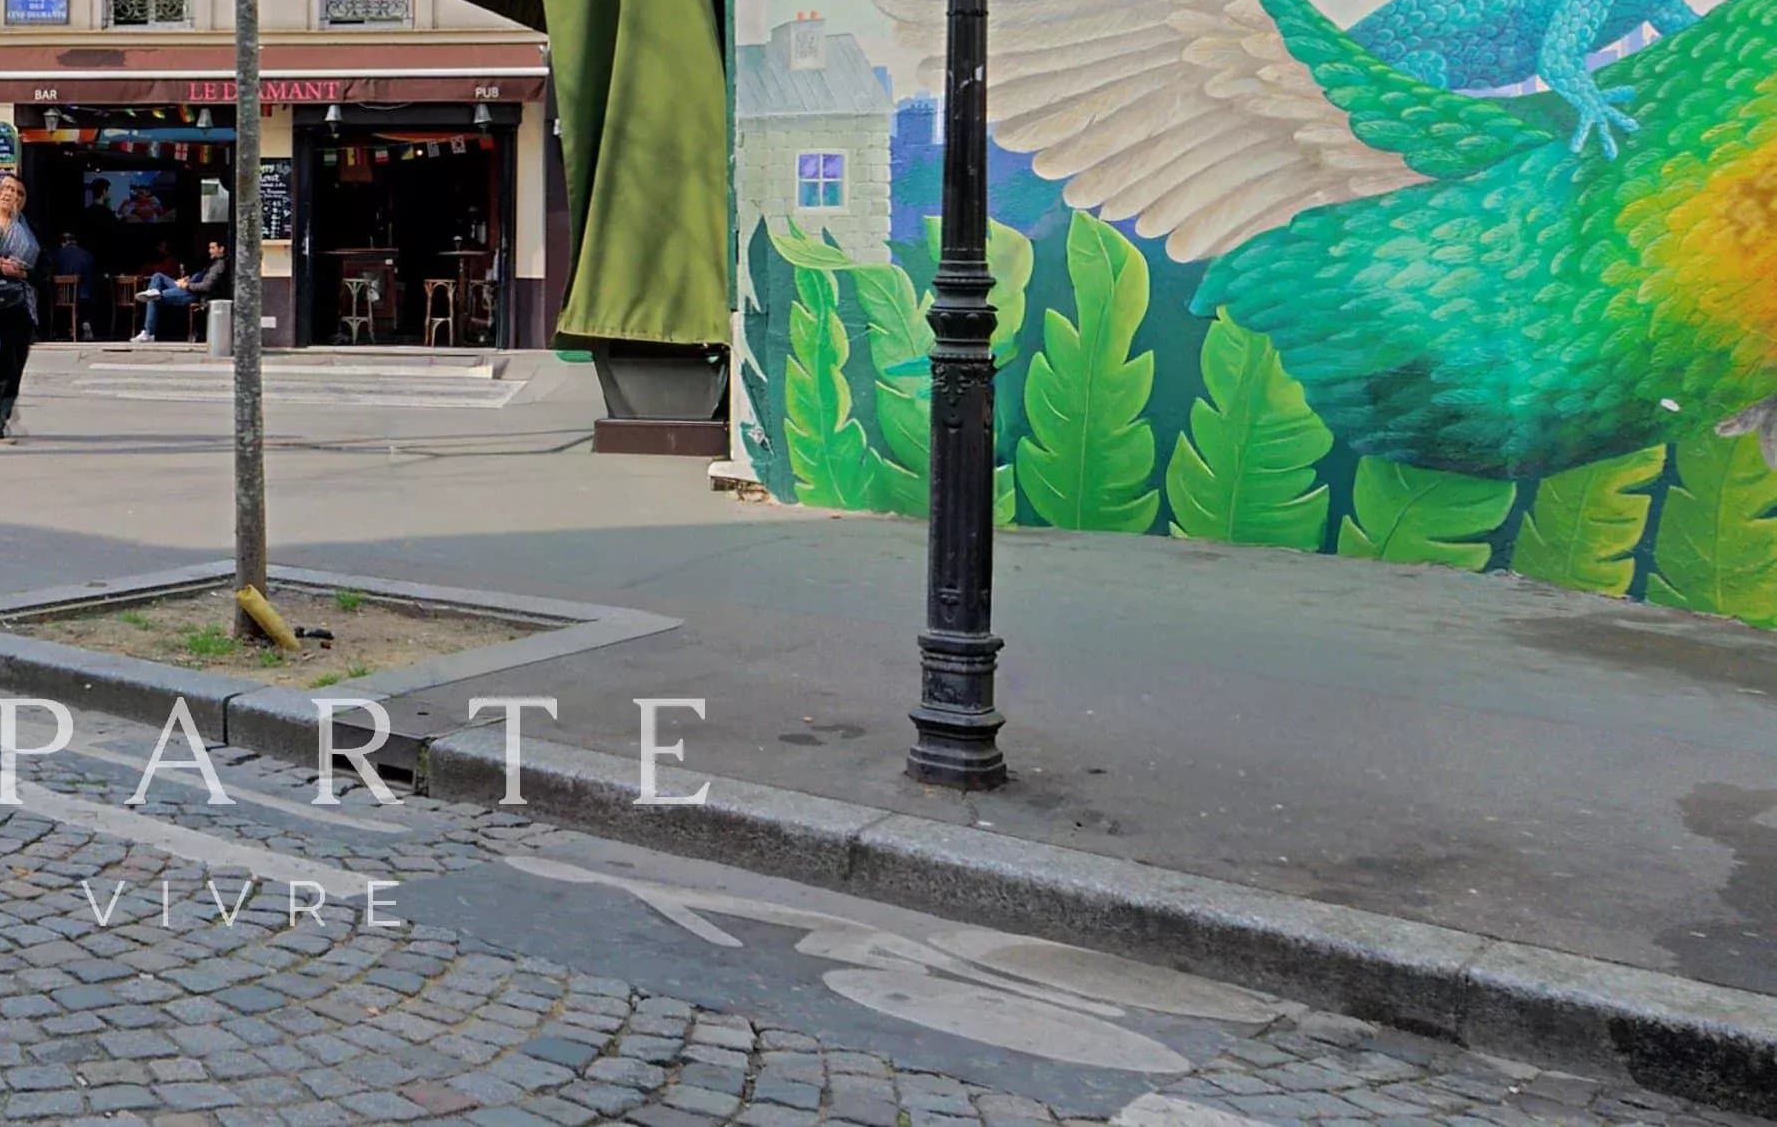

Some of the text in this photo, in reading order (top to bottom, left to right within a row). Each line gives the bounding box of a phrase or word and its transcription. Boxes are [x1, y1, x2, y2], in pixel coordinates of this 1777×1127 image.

[34, 89, 58, 100] BAR
[189, 81, 340, 100] LE DMANT
[475, 86, 499, 99] PUB
